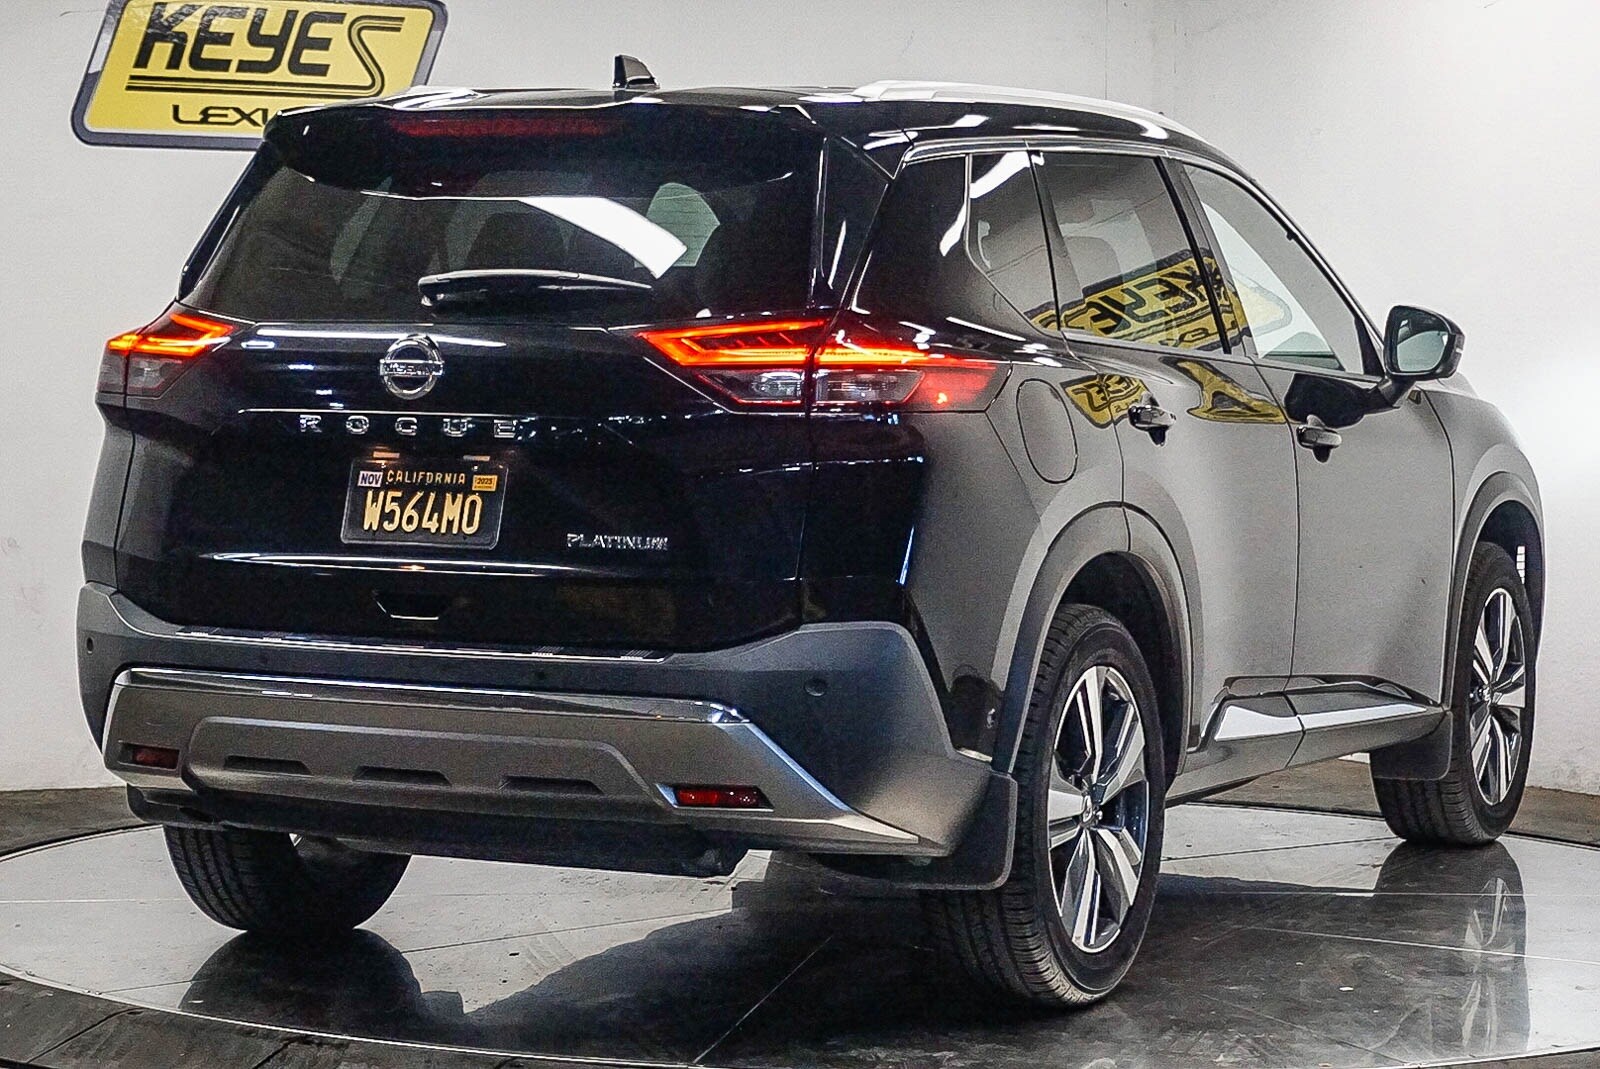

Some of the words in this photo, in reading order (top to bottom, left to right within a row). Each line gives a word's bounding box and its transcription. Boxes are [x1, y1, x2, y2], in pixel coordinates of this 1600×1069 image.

[132, 2, 405, 98] KEYES
[172, 104, 269, 127] LEX
[299, 414, 518, 438] ROGUE
[360, 473, 381, 486] NOV
[386, 469, 466, 485] CALIFORNIA
[566, 533, 669, 551] PLATINUM
